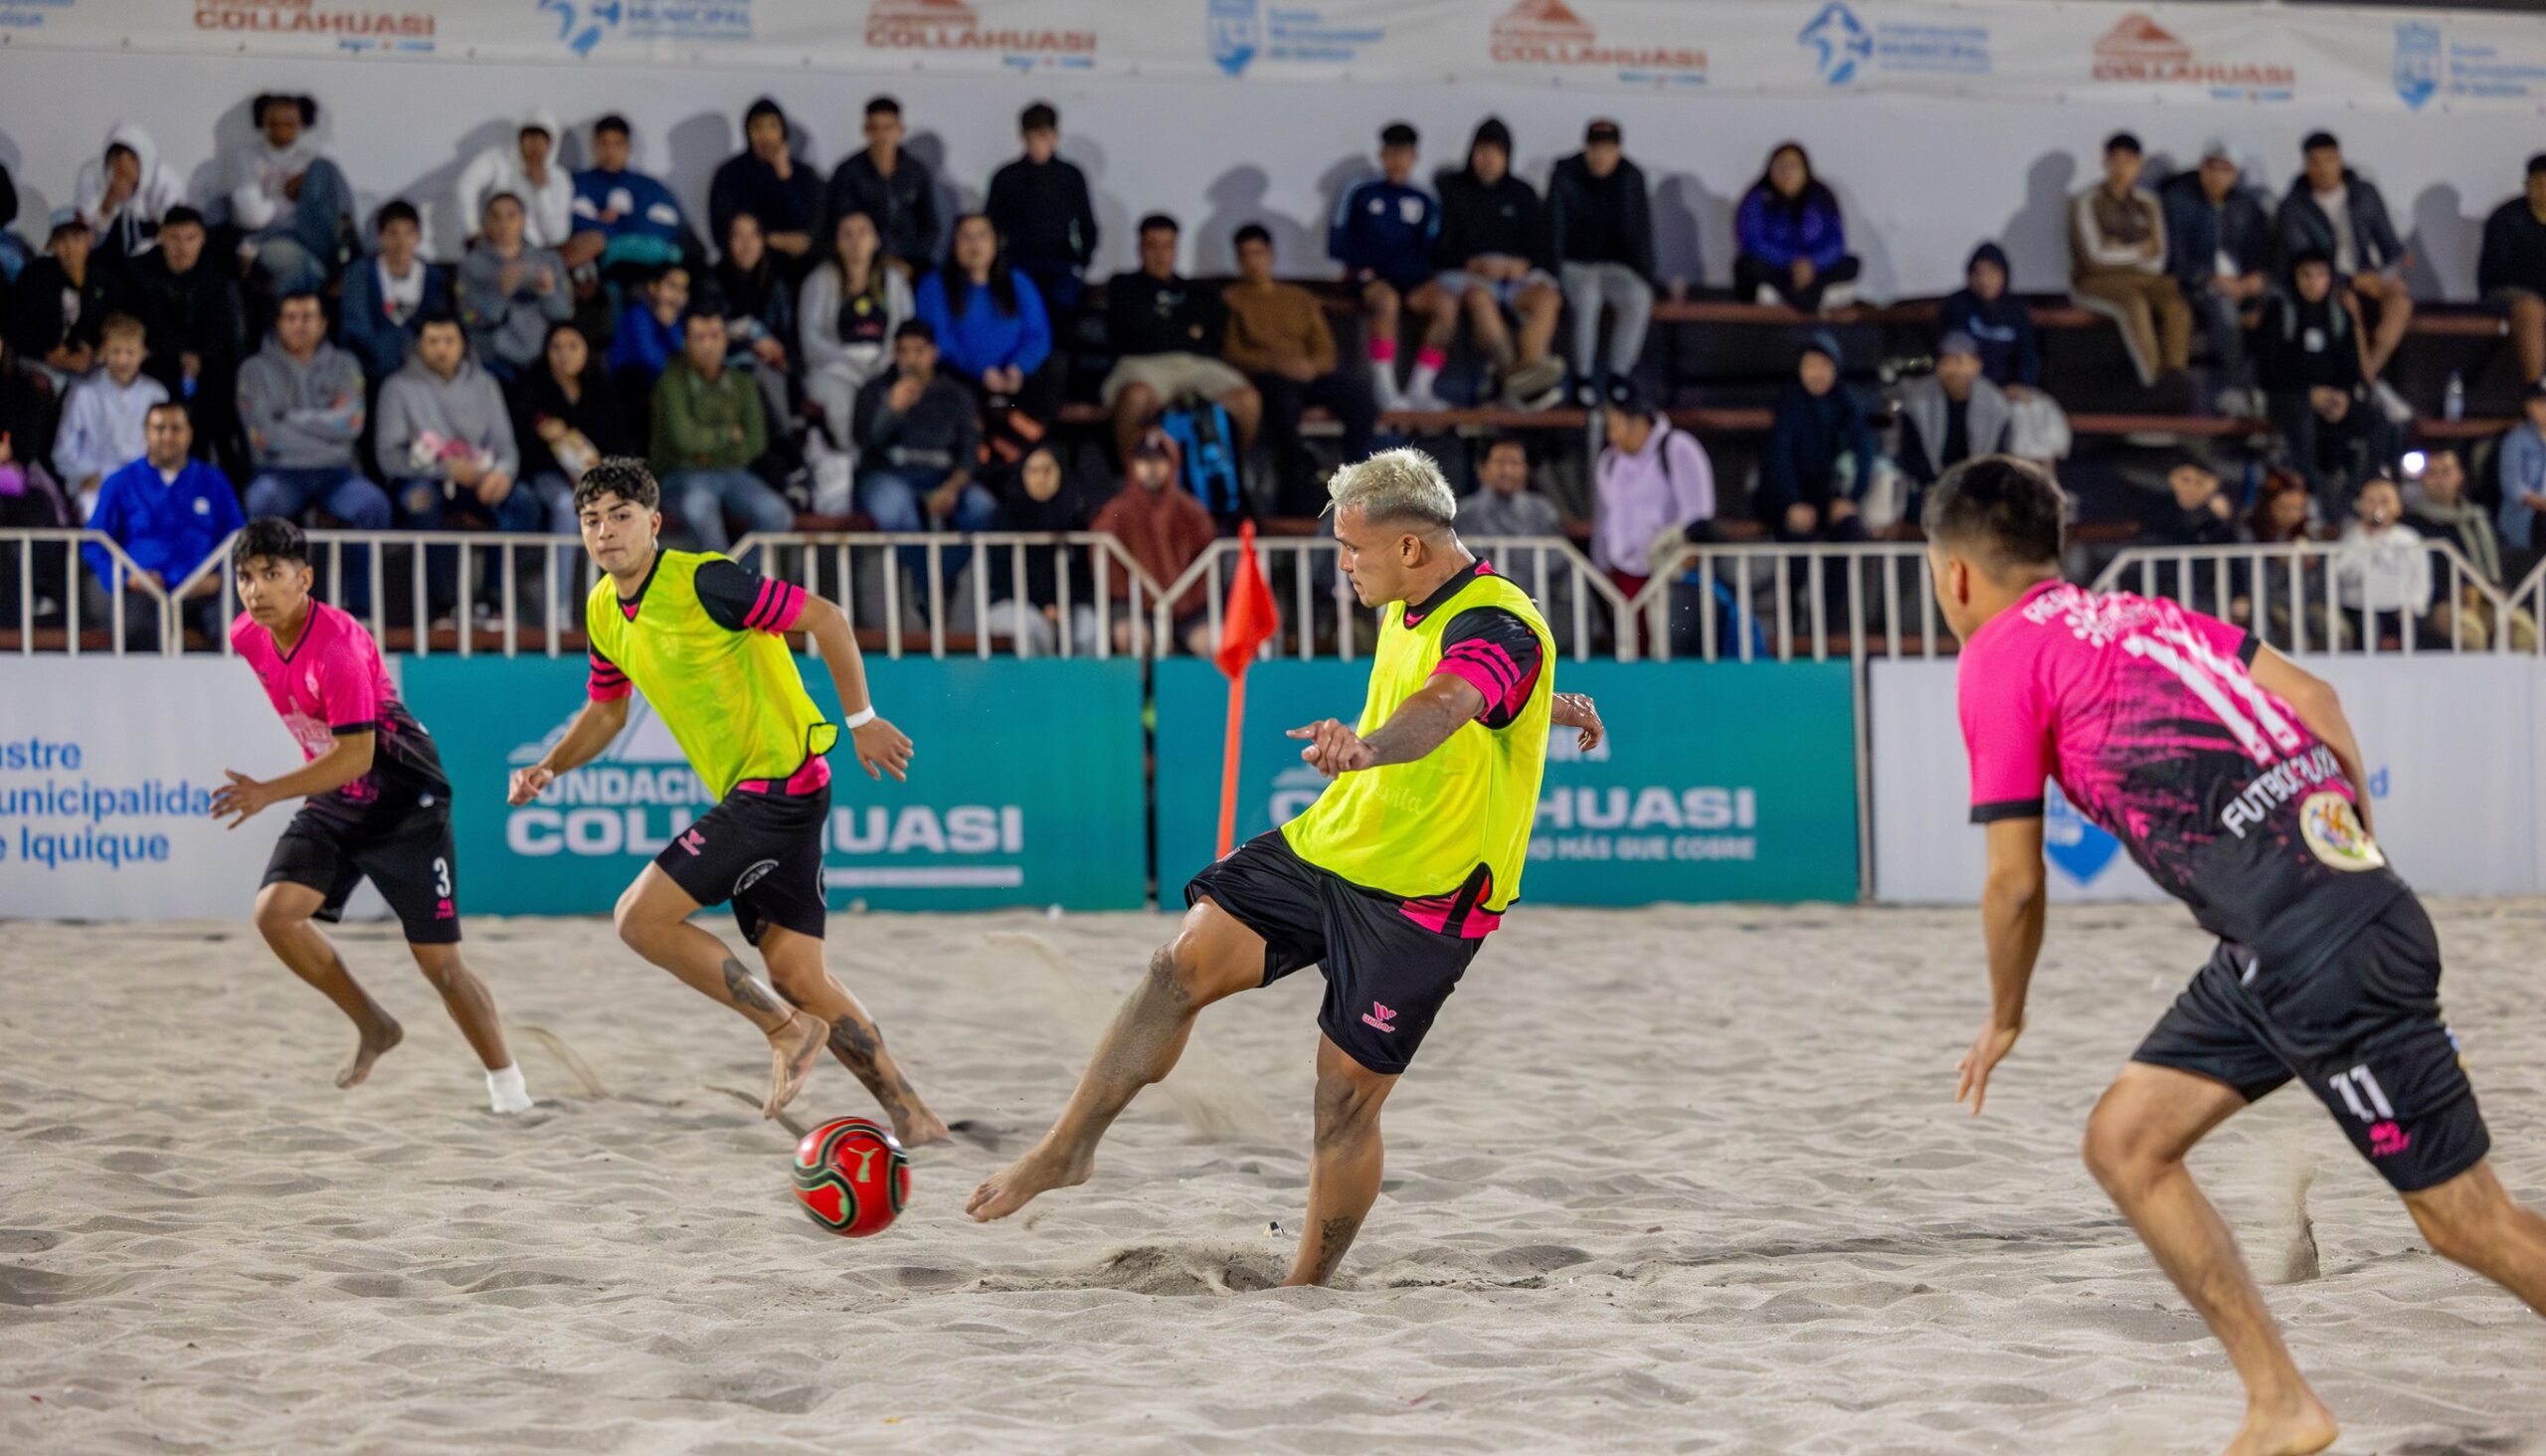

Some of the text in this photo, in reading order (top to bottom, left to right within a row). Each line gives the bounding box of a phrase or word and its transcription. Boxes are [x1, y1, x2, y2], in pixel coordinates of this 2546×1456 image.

[194, 10, 436, 38] COLLAHUASI
[0, 736, 83, 771] stre
[21, 824, 170, 870] Iquique
[433, 856, 452, 898] 3
[2328, 1063, 2395, 1124] 11
